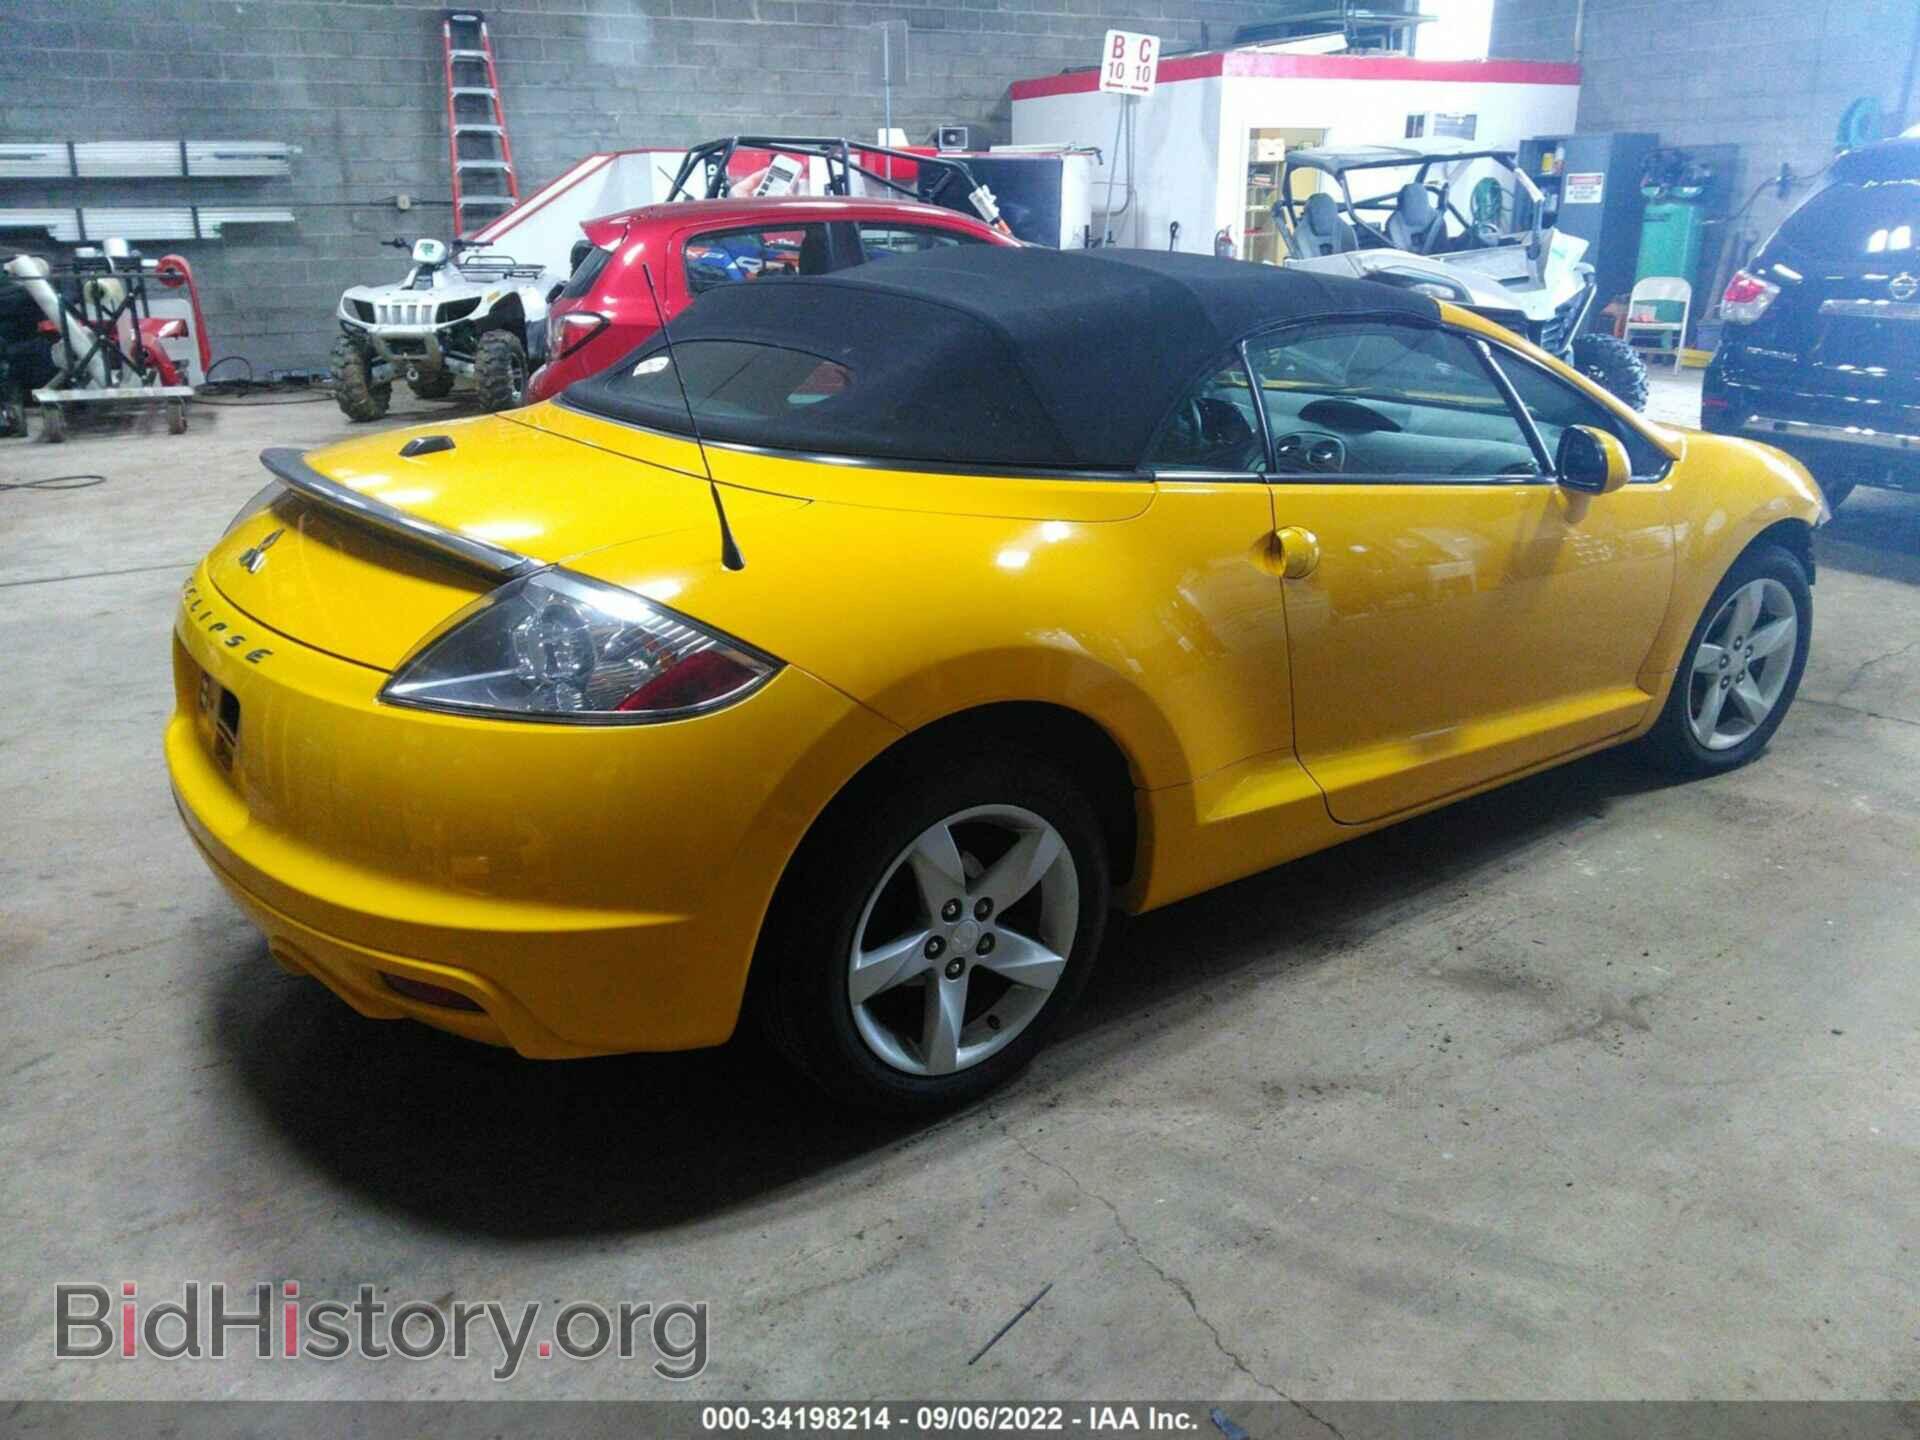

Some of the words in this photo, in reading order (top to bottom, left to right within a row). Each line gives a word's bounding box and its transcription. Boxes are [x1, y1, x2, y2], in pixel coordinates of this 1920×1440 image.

[1112, 34, 1126, 59] B
[1139, 38, 1151, 63] C
[1108, 61, 1125, 79] 10
[1136, 65, 1151, 82] 10
